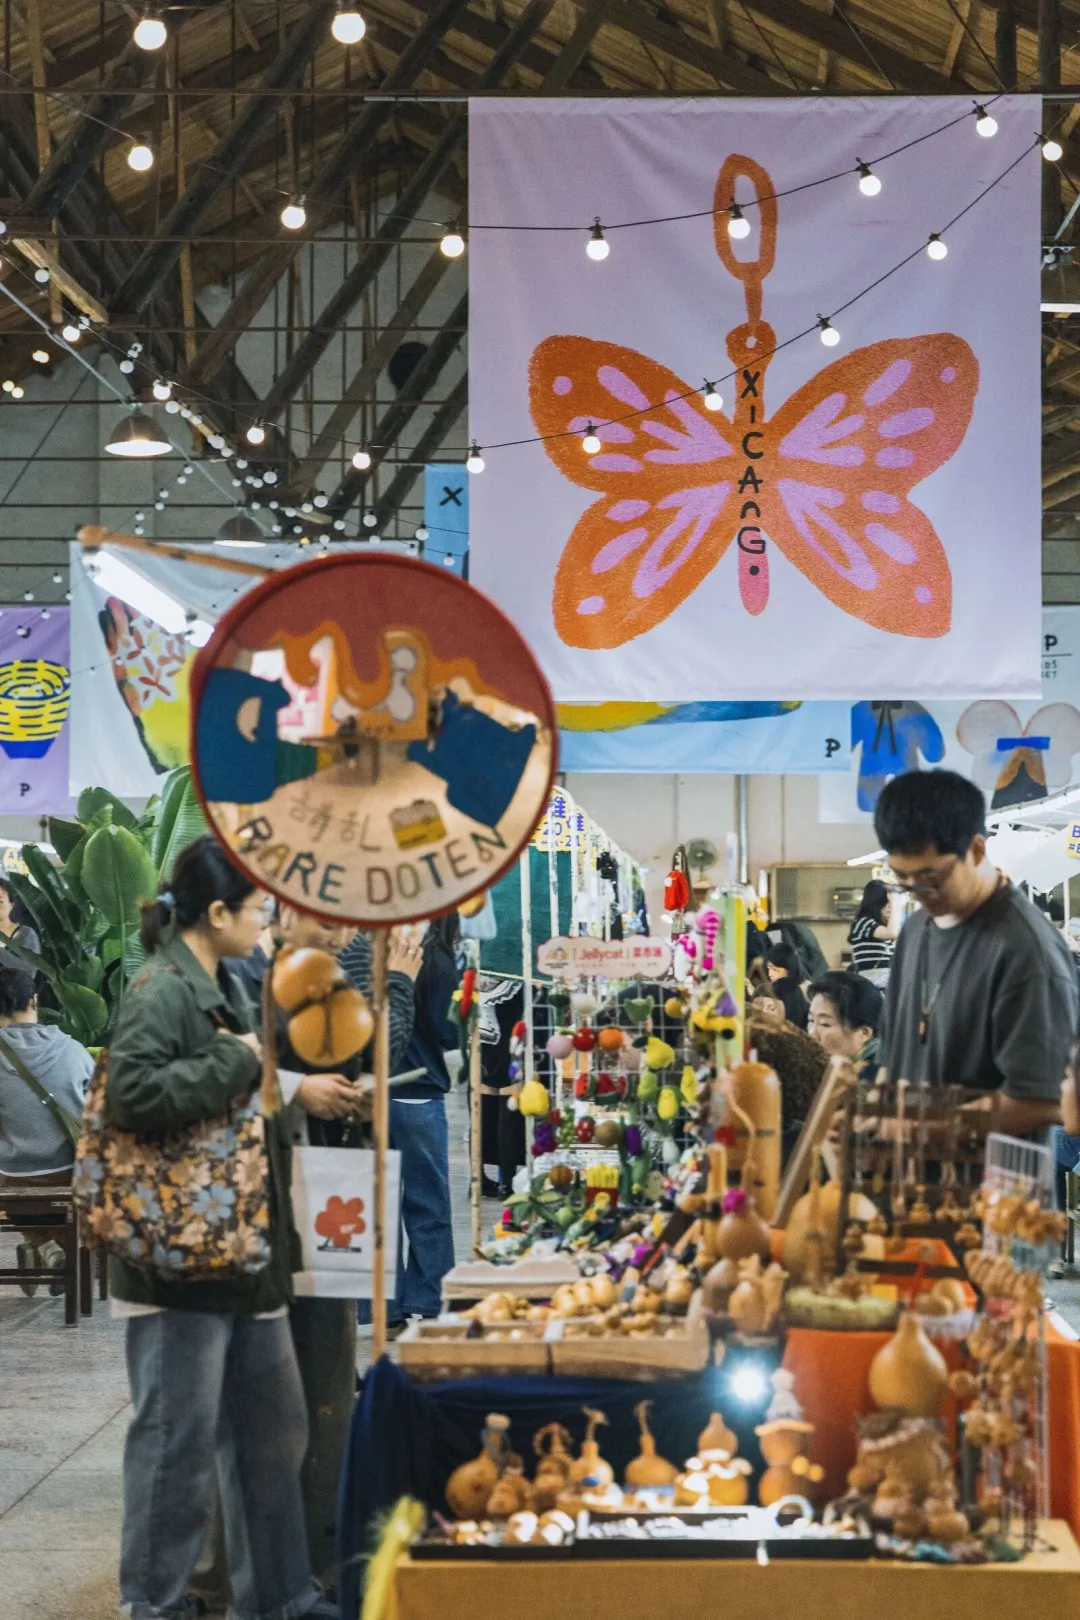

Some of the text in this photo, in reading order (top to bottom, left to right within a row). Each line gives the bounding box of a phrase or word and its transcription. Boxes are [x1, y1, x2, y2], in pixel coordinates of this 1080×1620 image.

[1043, 634, 1059, 651] P
[825, 738, 842, 758] P
[20, 782, 31, 797] P
